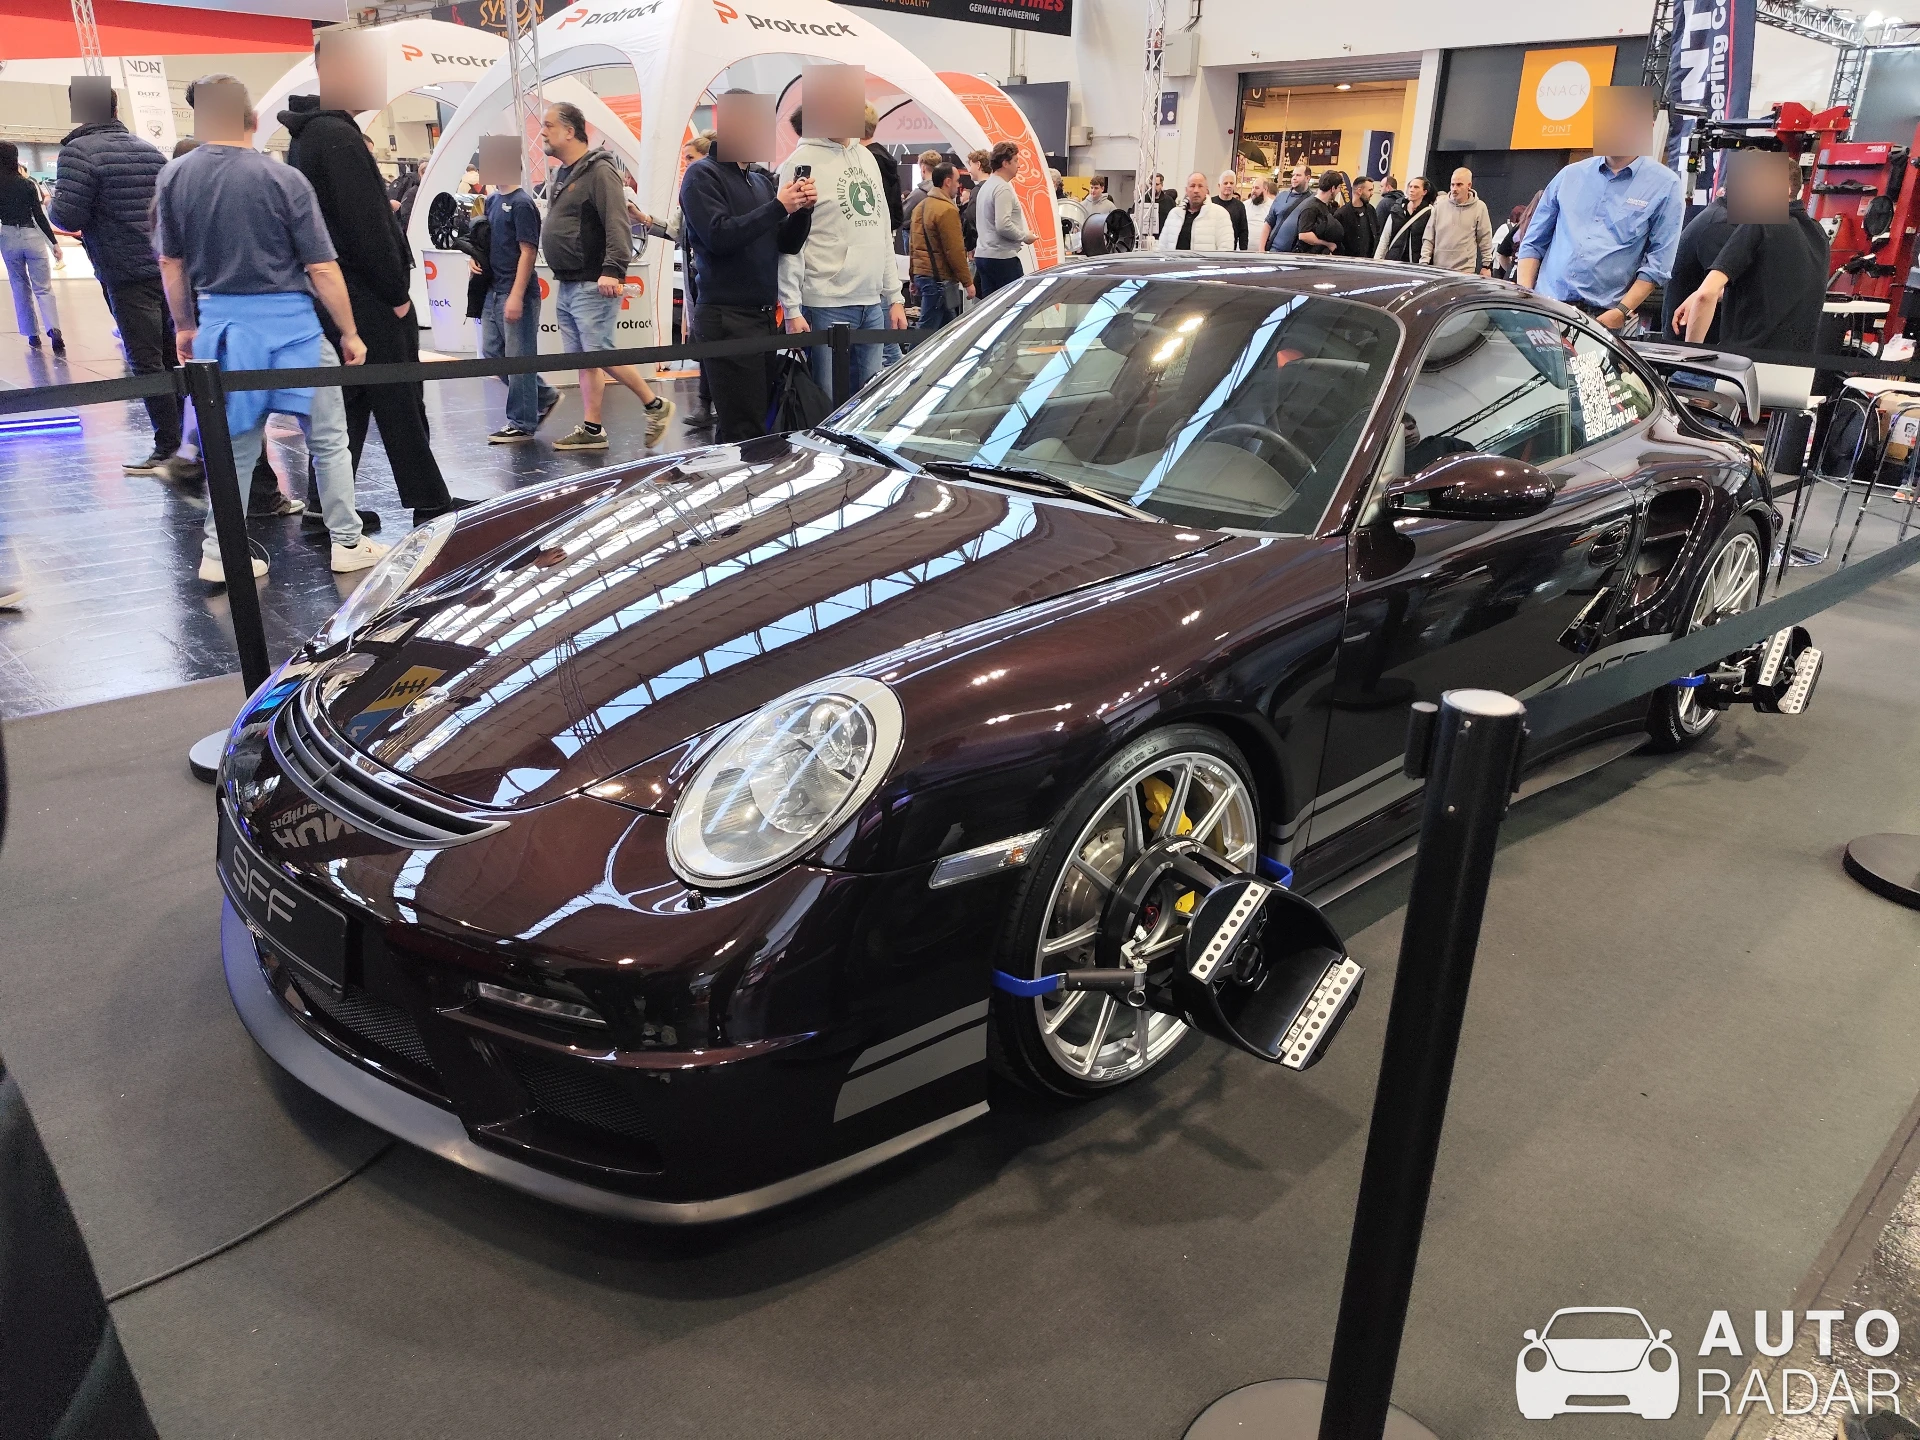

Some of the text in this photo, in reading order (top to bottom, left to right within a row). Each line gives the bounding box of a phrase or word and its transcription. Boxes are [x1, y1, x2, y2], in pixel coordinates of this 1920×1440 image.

[580, 1, 663, 28] protrack
[969, 3, 1040, 21] GERMAN ENGINEERING
[745, 14, 859, 37] protrack
[431, 53, 497, 67] protr
[1539, 85, 1588, 97] SNACK
[1542, 124, 1572, 133] POINT
[1379, 140, 1390, 174] 8
